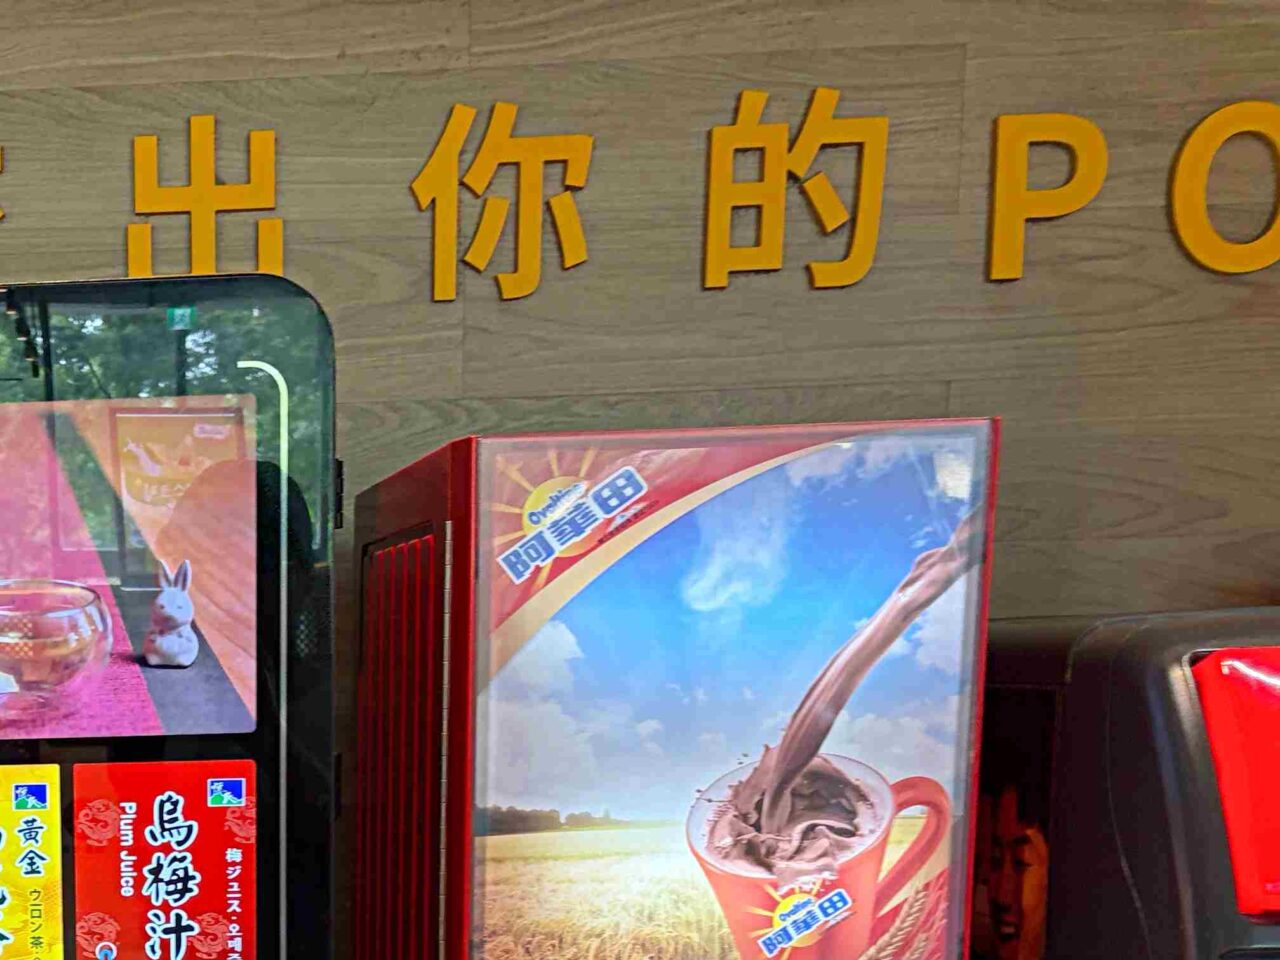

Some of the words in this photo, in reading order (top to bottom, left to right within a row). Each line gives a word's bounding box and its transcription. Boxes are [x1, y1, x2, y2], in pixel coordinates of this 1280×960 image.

[498, 466, 647, 583] 阿華田
[17, 817, 48, 876] 黃金
[120, 801, 136, 846] Plum
[120, 850, 138, 897] Juice
